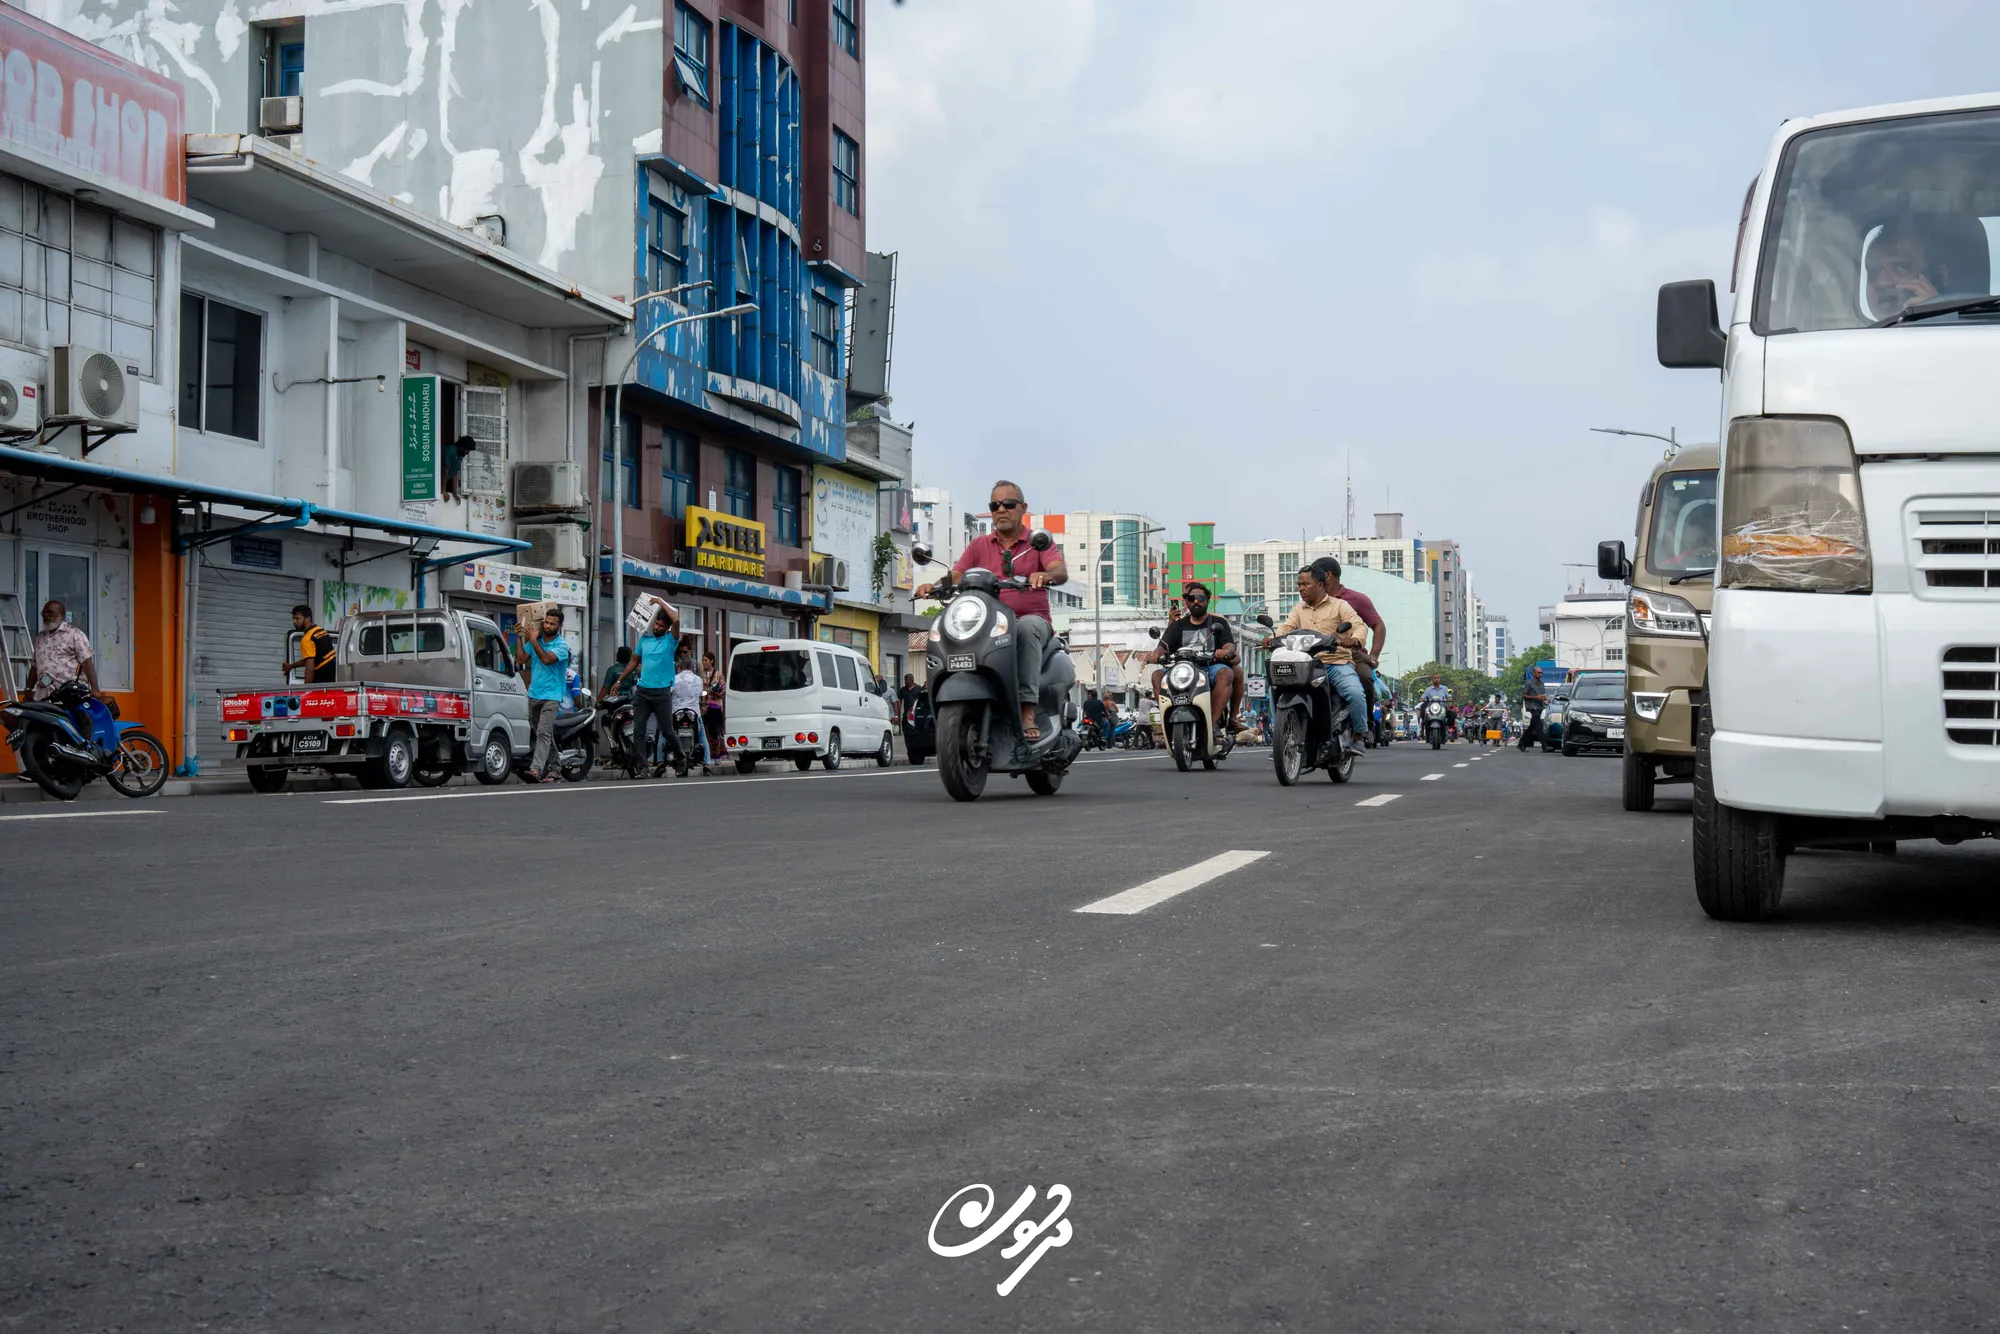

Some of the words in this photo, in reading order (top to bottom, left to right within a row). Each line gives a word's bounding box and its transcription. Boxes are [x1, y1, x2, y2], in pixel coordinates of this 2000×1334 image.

[24, 388, 34, 396] TCL
[422, 383, 430, 431] BANDHARU
[422, 432, 430, 462] SOSUN
[27, 511, 87, 526] BROTHERHOOD
[47, 523, 69, 533] SHOP
[713, 519, 765, 554] STEEL
[697, 551, 765, 578] HARDWARE
[950, 661, 973, 669] P4493
[499, 682, 517, 692] 350KG
[298, 740, 321, 748] C5109
